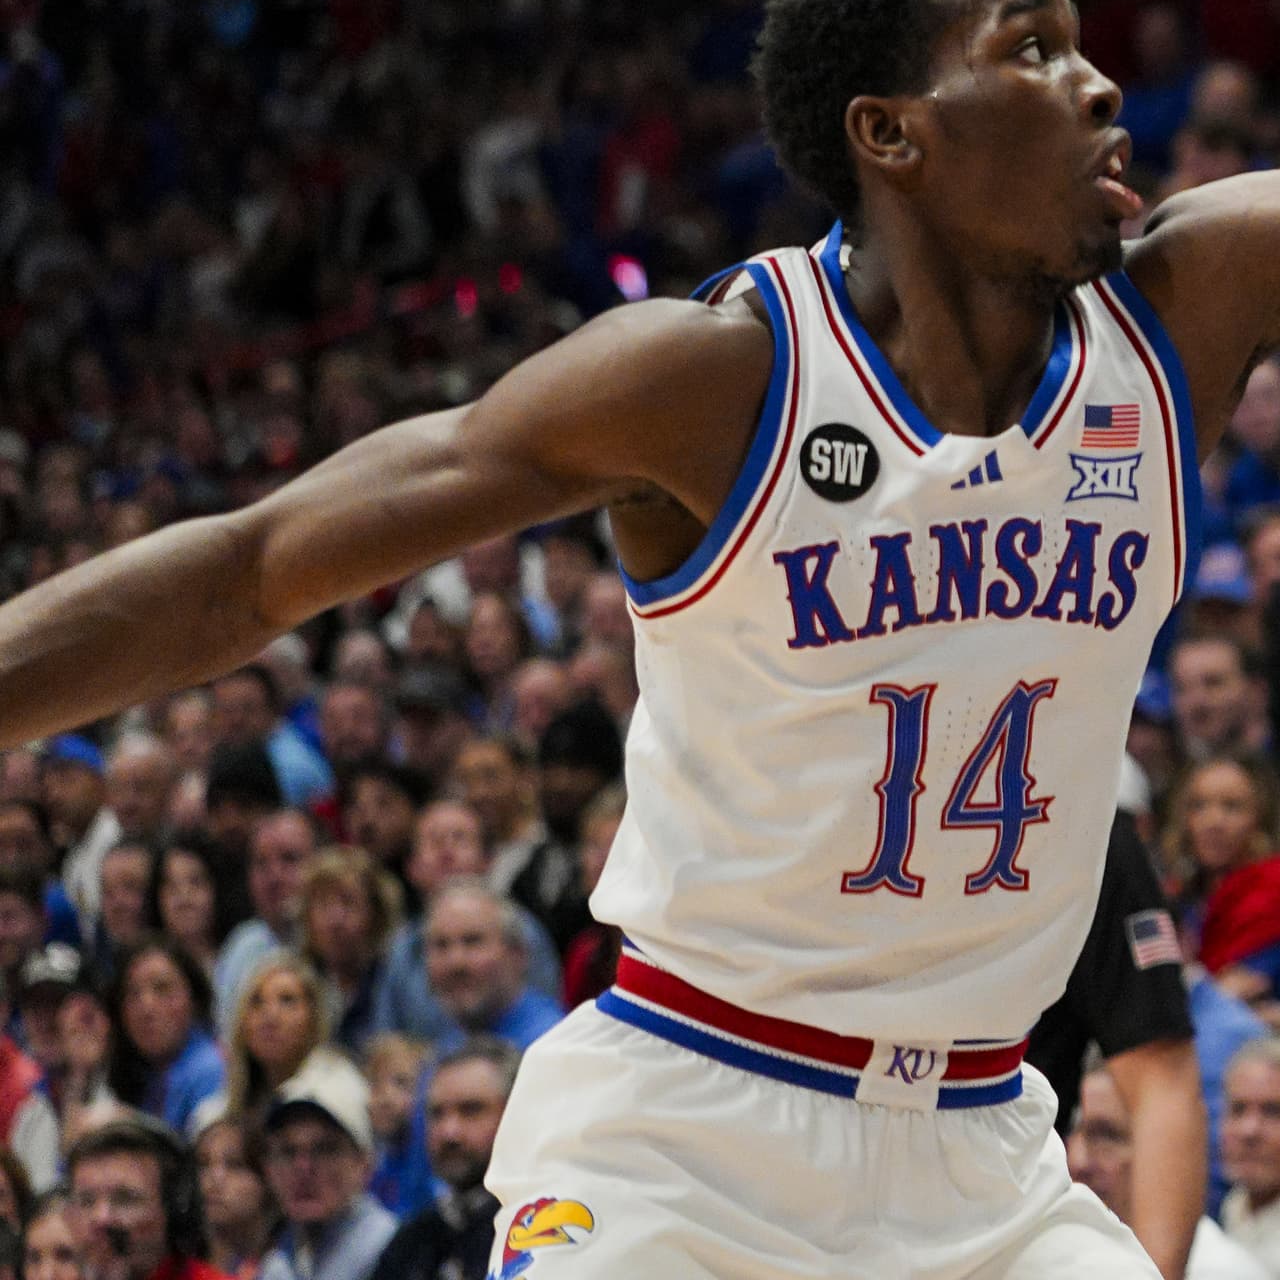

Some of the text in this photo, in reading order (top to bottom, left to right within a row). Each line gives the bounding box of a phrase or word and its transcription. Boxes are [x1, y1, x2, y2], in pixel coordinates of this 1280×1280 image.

[809, 438, 868, 486] SW
[1065, 452, 1142, 502] XII
[773, 517, 1150, 649] KANSAS
[840, 678, 1058, 898] 14
[884, 1044, 937, 1085] KU
